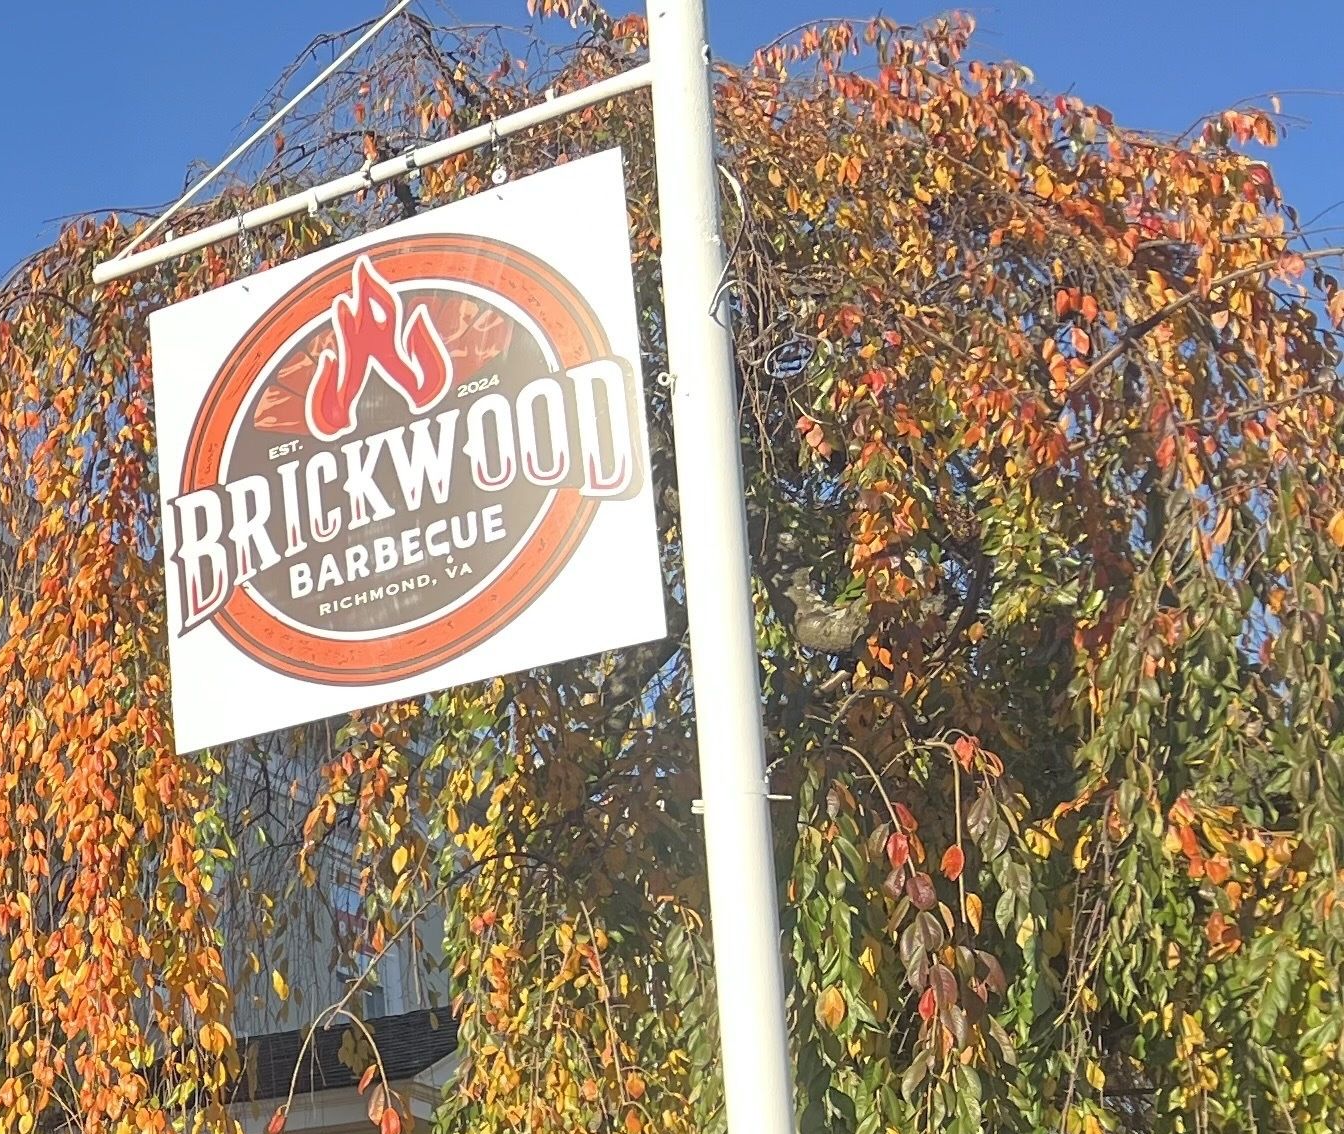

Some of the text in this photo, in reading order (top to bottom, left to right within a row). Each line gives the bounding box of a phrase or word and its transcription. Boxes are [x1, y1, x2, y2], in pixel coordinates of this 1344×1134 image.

[268, 373, 501, 460] EST. 2024
[170, 357, 634, 633] BRICKWOOD
[288, 503, 507, 600] BARBECUE
[318, 563, 473, 617] RICHMOND, VA
